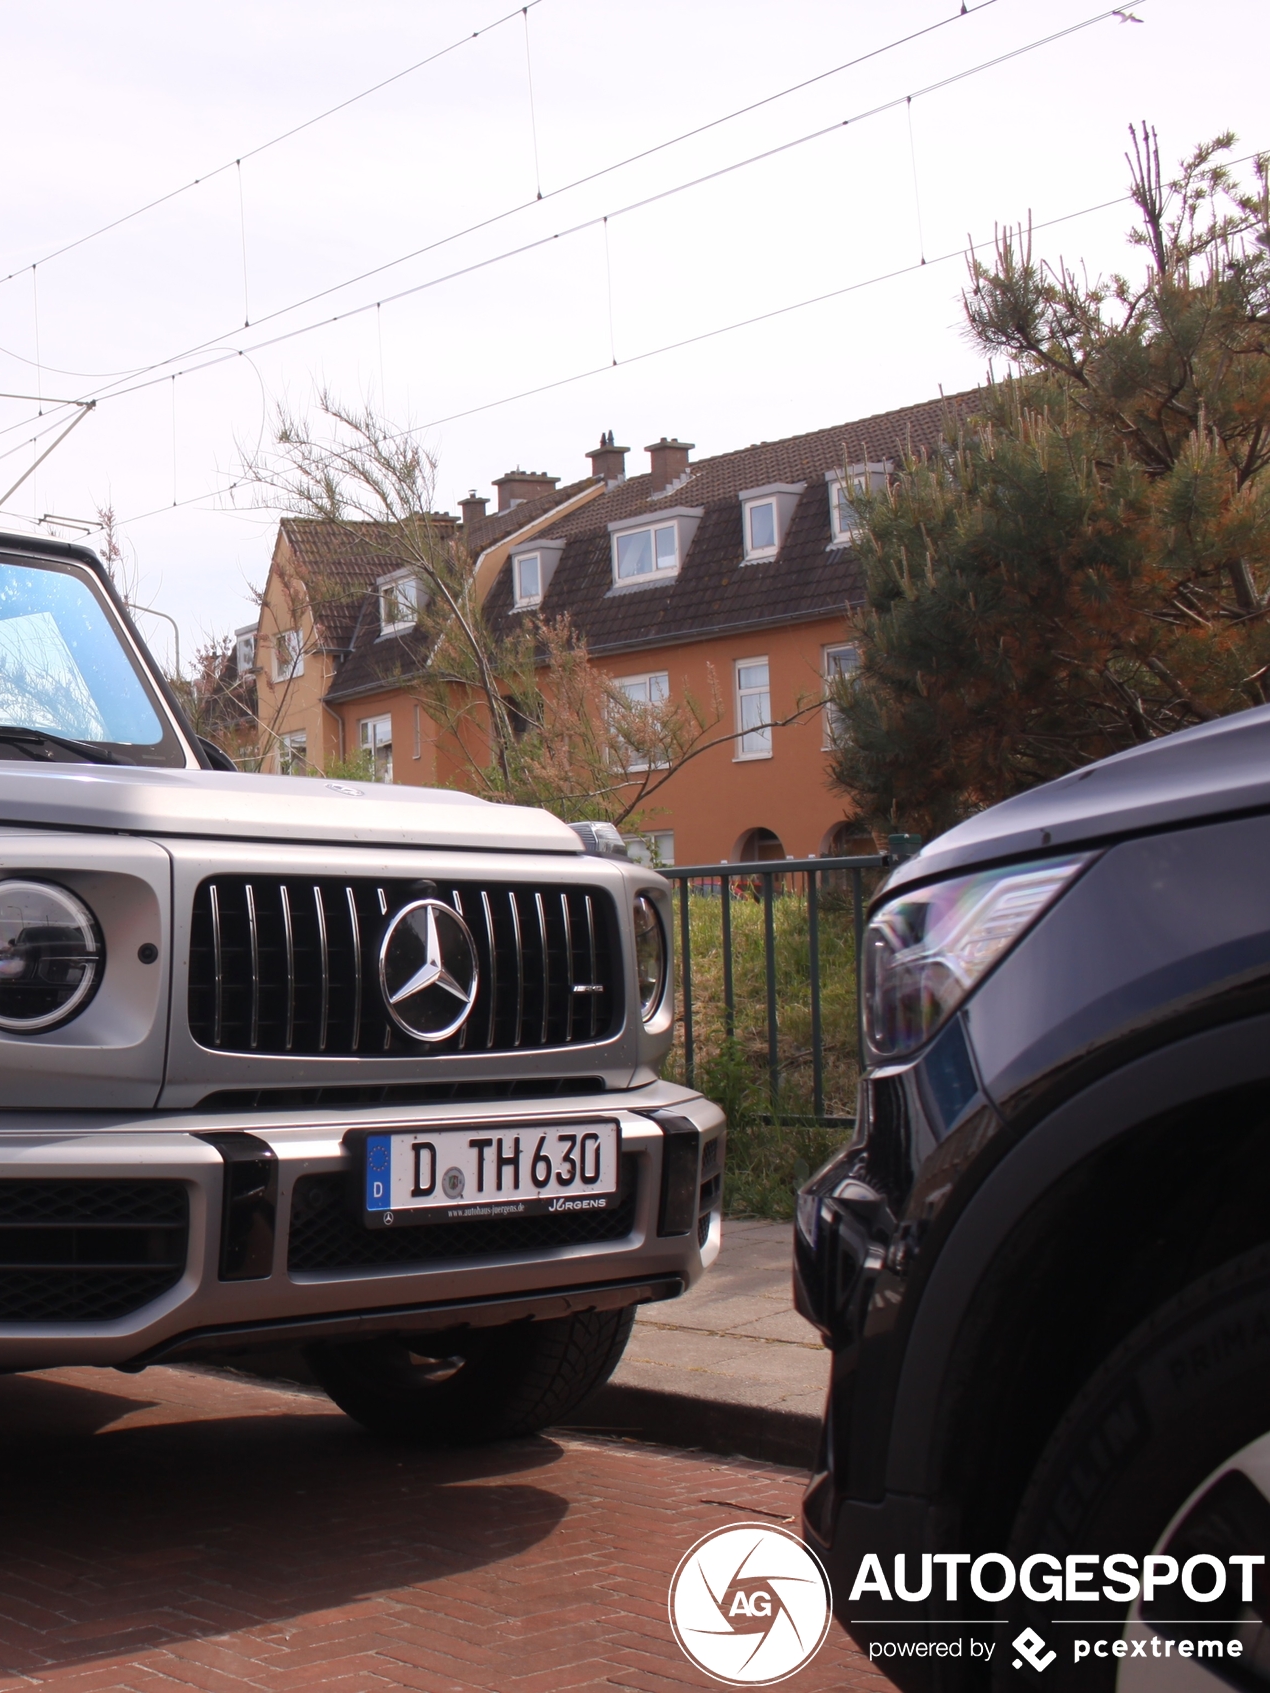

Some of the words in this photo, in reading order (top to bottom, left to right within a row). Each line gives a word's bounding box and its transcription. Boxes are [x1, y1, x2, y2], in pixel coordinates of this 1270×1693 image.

[411, 1142, 437, 1198] D
[373, 1181, 383, 1198] D
[448, 1202, 525, 1217] www.autohaus-juergens.de
